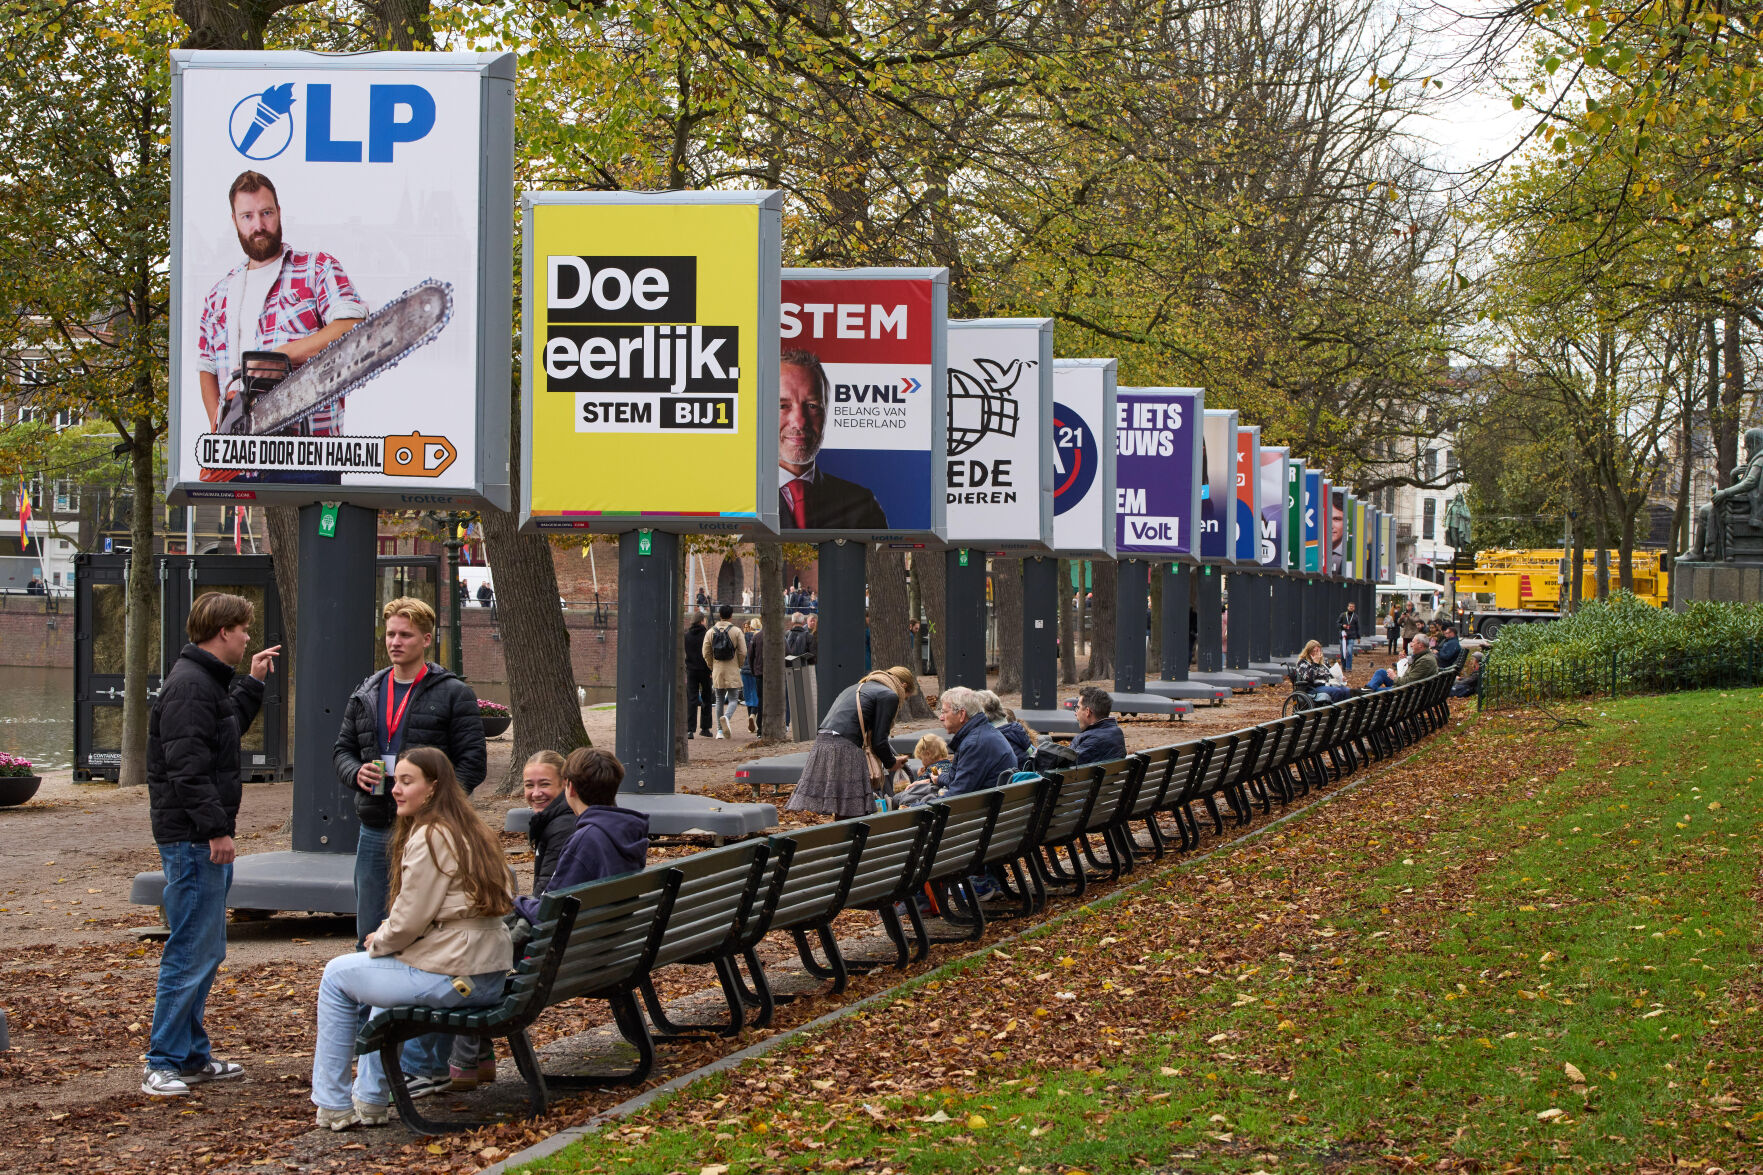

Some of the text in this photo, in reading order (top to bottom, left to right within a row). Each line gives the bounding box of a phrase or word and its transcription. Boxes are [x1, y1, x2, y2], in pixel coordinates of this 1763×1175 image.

[305, 83, 437, 163] LP
[547, 255, 670, 311] Doe
[780, 302, 908, 340] STEM
[545, 325, 740, 394] eerlijk.
[834, 384, 906, 404] BVNL
[582, 402, 729, 424] STEM BIJ1
[833, 418, 907, 429] NEDERLAND
[834, 406, 906, 417] BELANG VAN
[1133, 403, 1183, 430] IETS
[1059, 427, 1083, 448] 21
[203, 438, 382, 468] DE ZAAG DOOR DEN HAAG.NL
[947, 459, 1013, 488] EDE
[946, 492, 1017, 505] DIEREN
[1130, 521, 1173, 541] Volt
